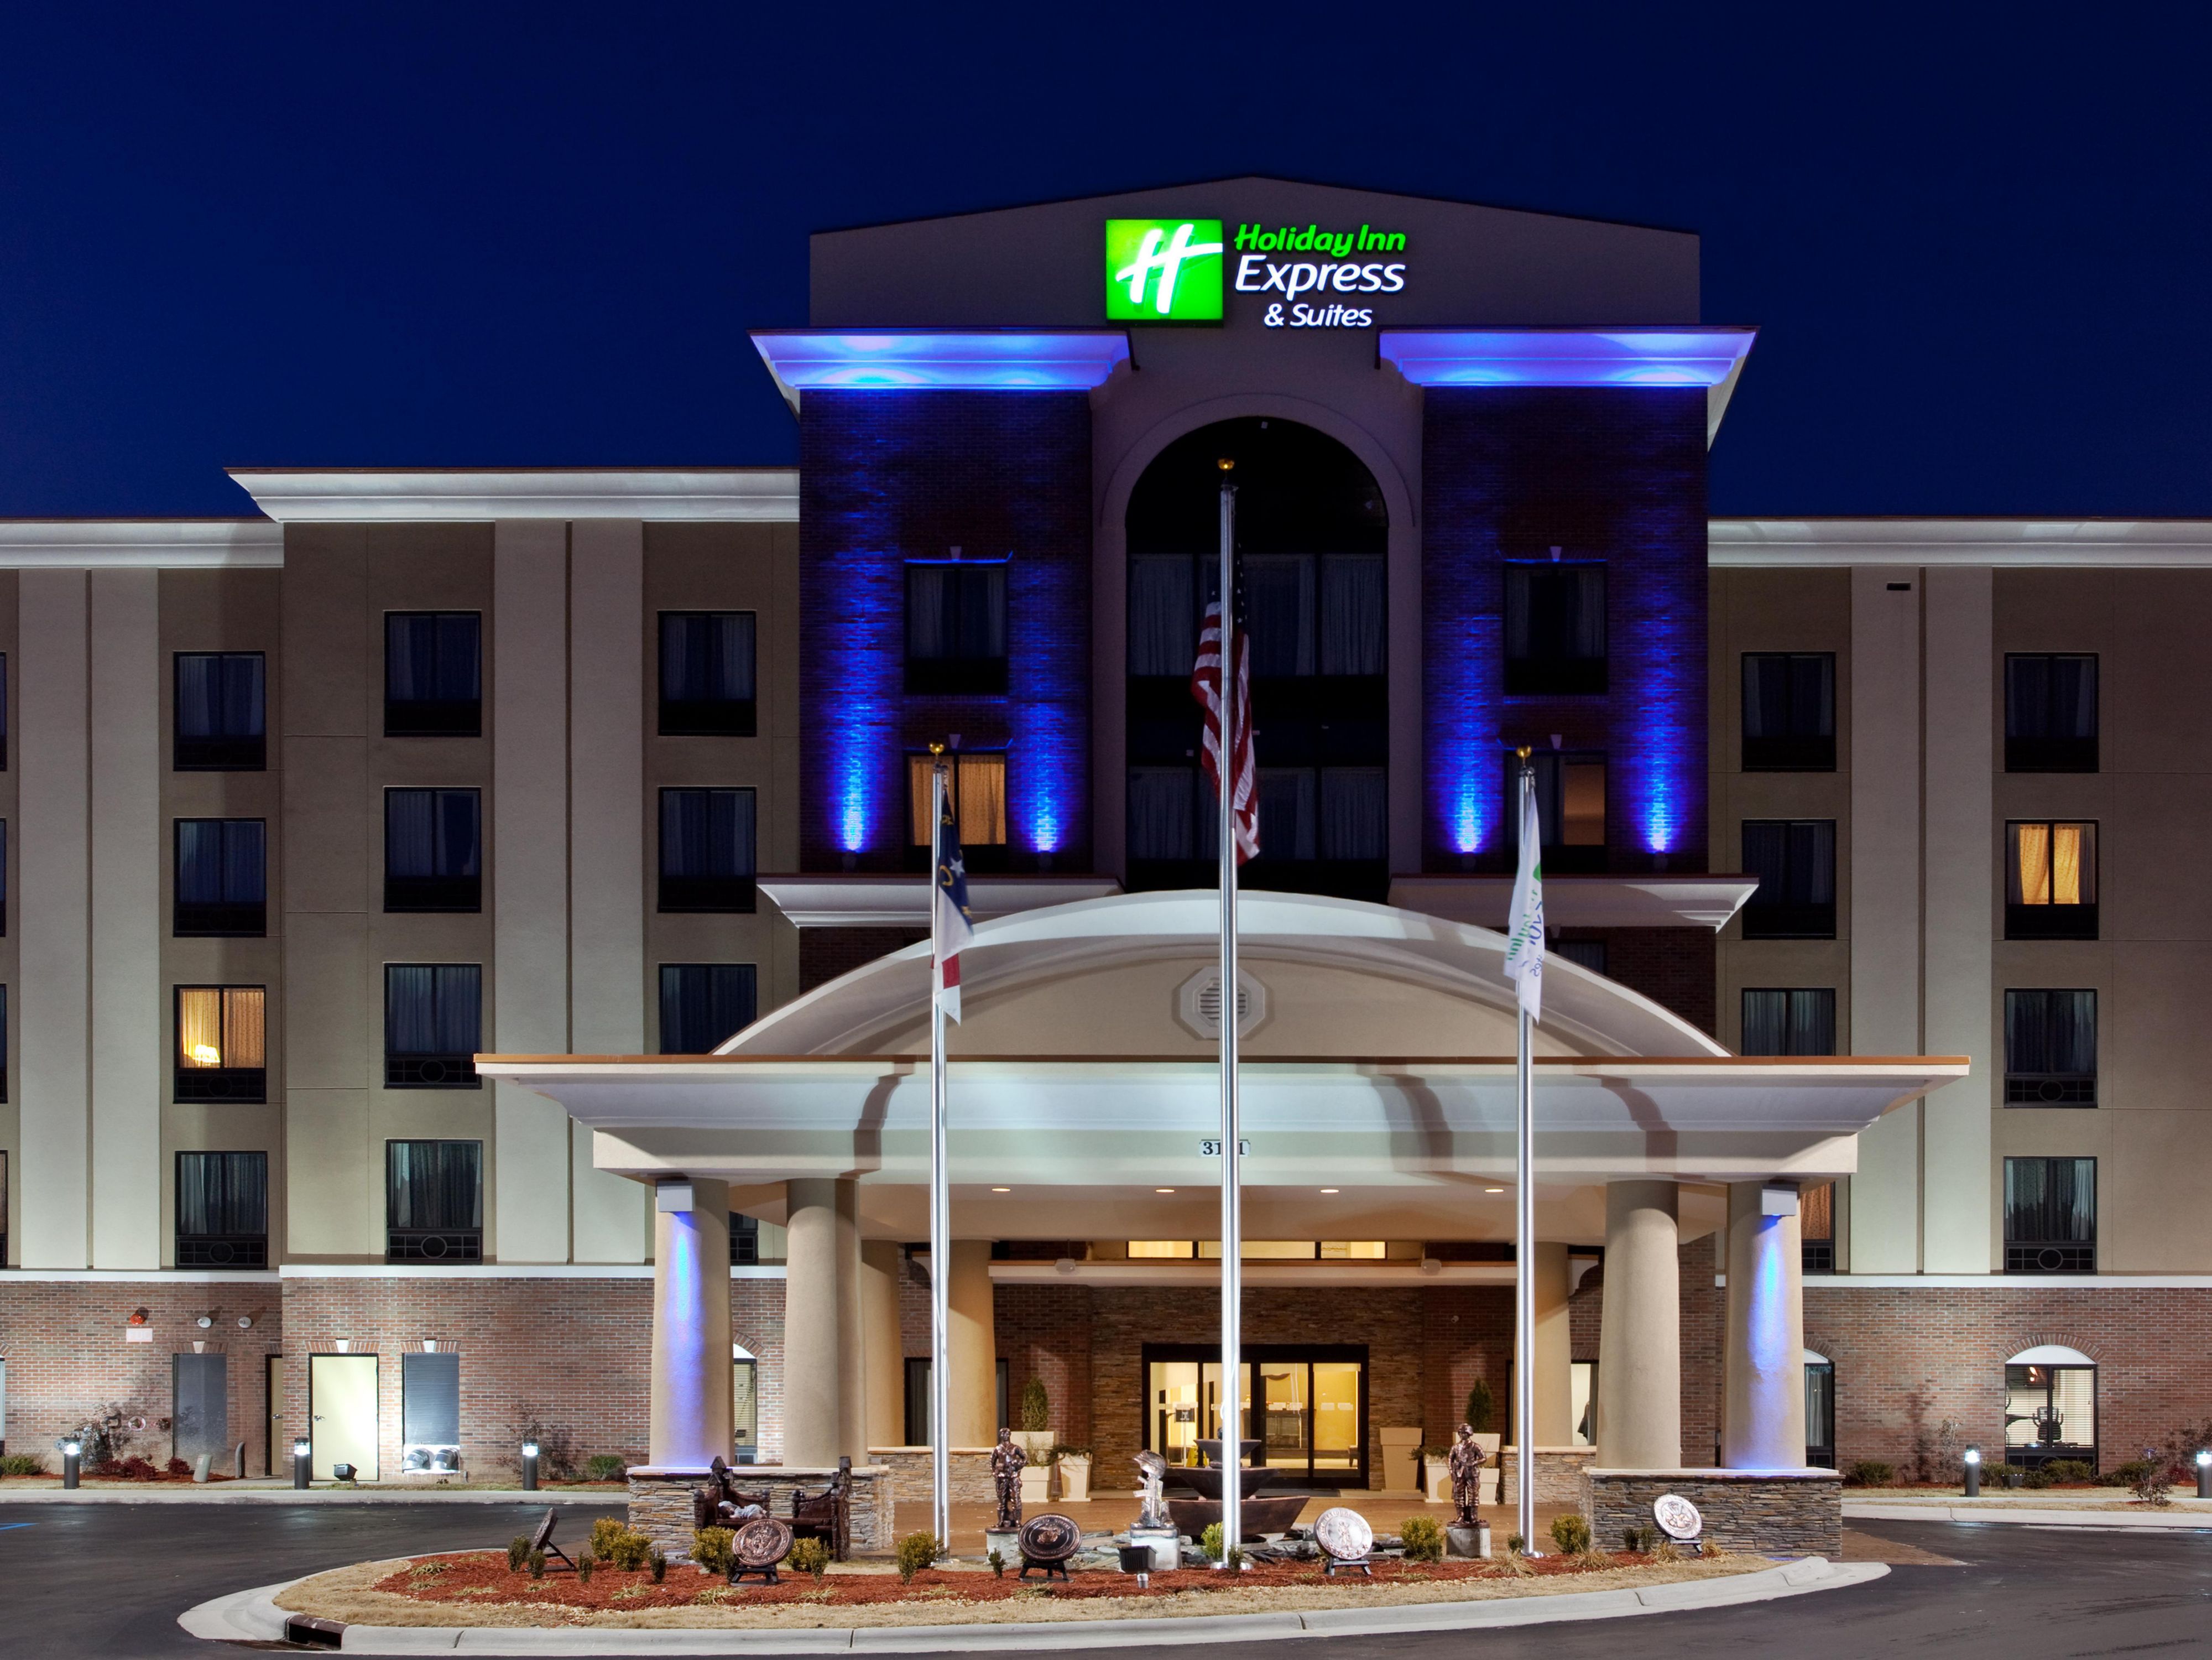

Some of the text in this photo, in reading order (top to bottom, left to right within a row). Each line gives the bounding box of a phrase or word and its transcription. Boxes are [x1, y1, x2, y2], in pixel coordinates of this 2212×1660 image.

[1234, 224, 1406, 257] Holiday Inn
[1235, 254, 1406, 301] Express
[1264, 303, 1373, 326] & Suites
[1203, 1141, 1245, 1155] 311
